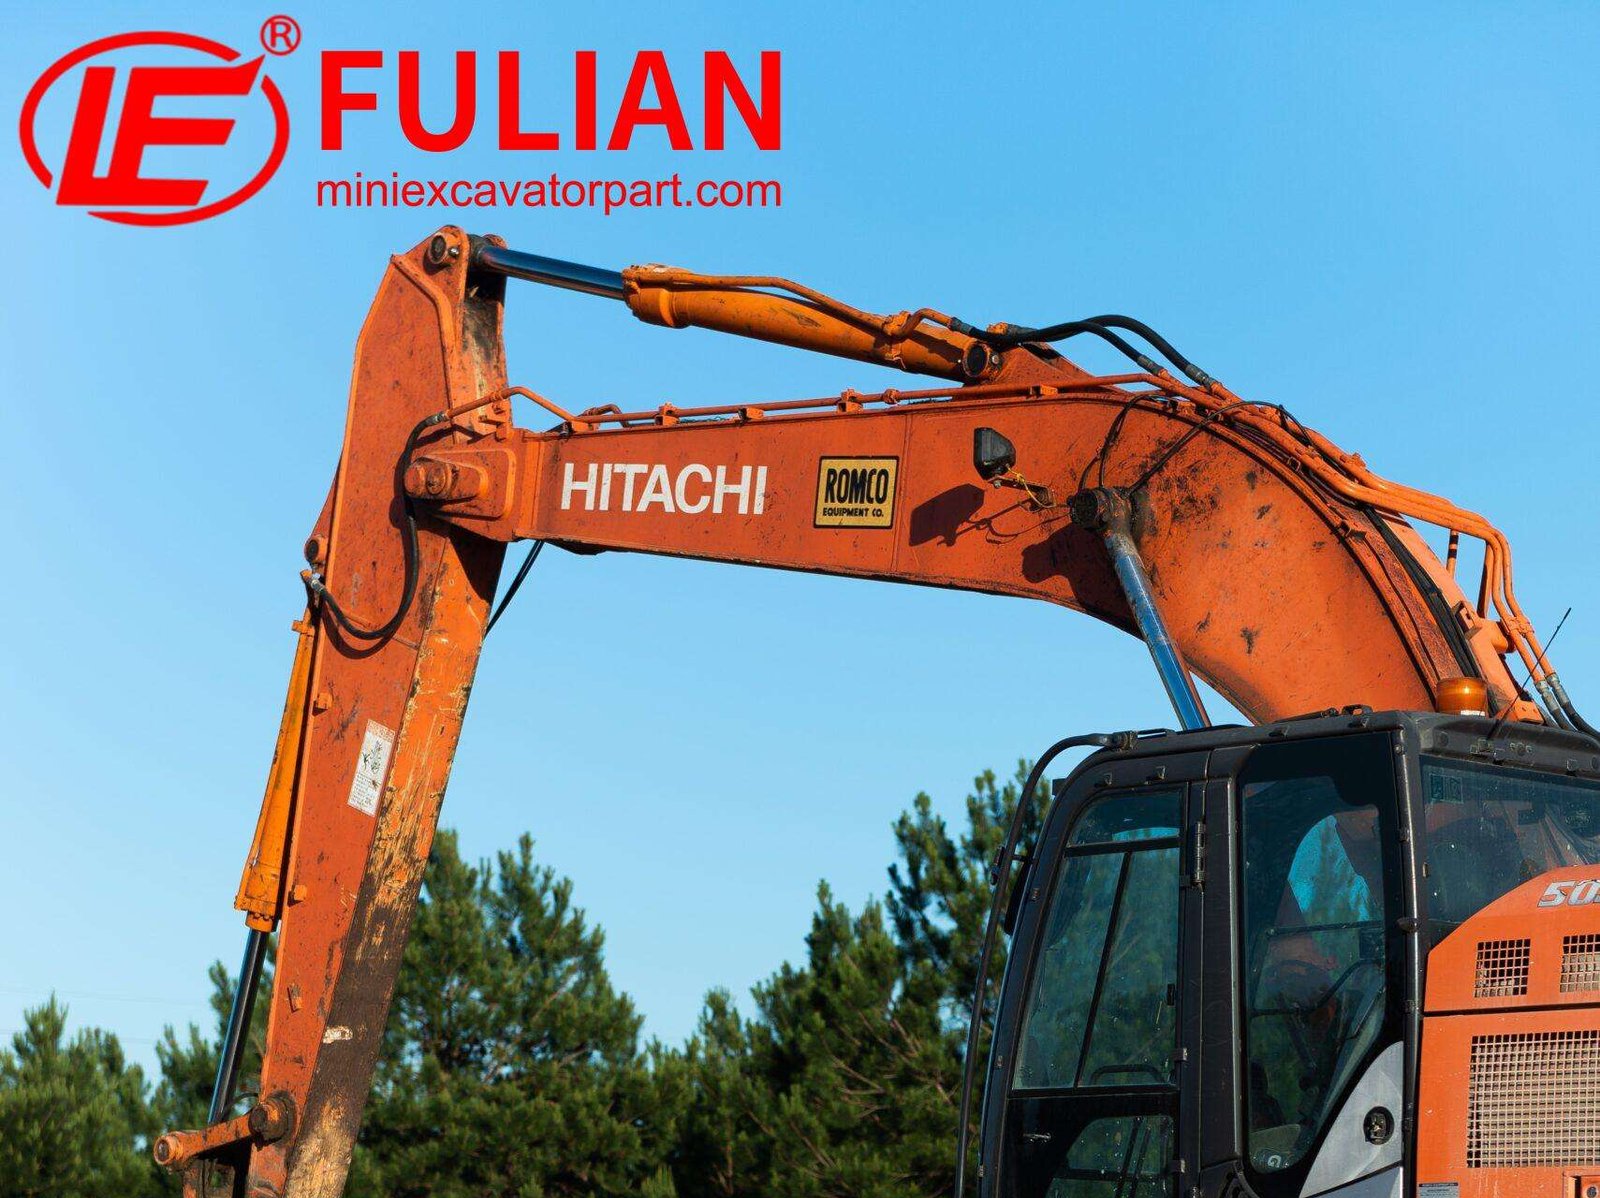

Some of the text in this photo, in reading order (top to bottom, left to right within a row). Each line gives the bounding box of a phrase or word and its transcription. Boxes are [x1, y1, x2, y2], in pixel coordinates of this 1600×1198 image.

[561, 463, 768, 515] HITACHI
[823, 467, 890, 504] ROMCO
[822, 507, 884, 518] EQUIPMENT CO.
[1536, 879, 1600, 908] 50
